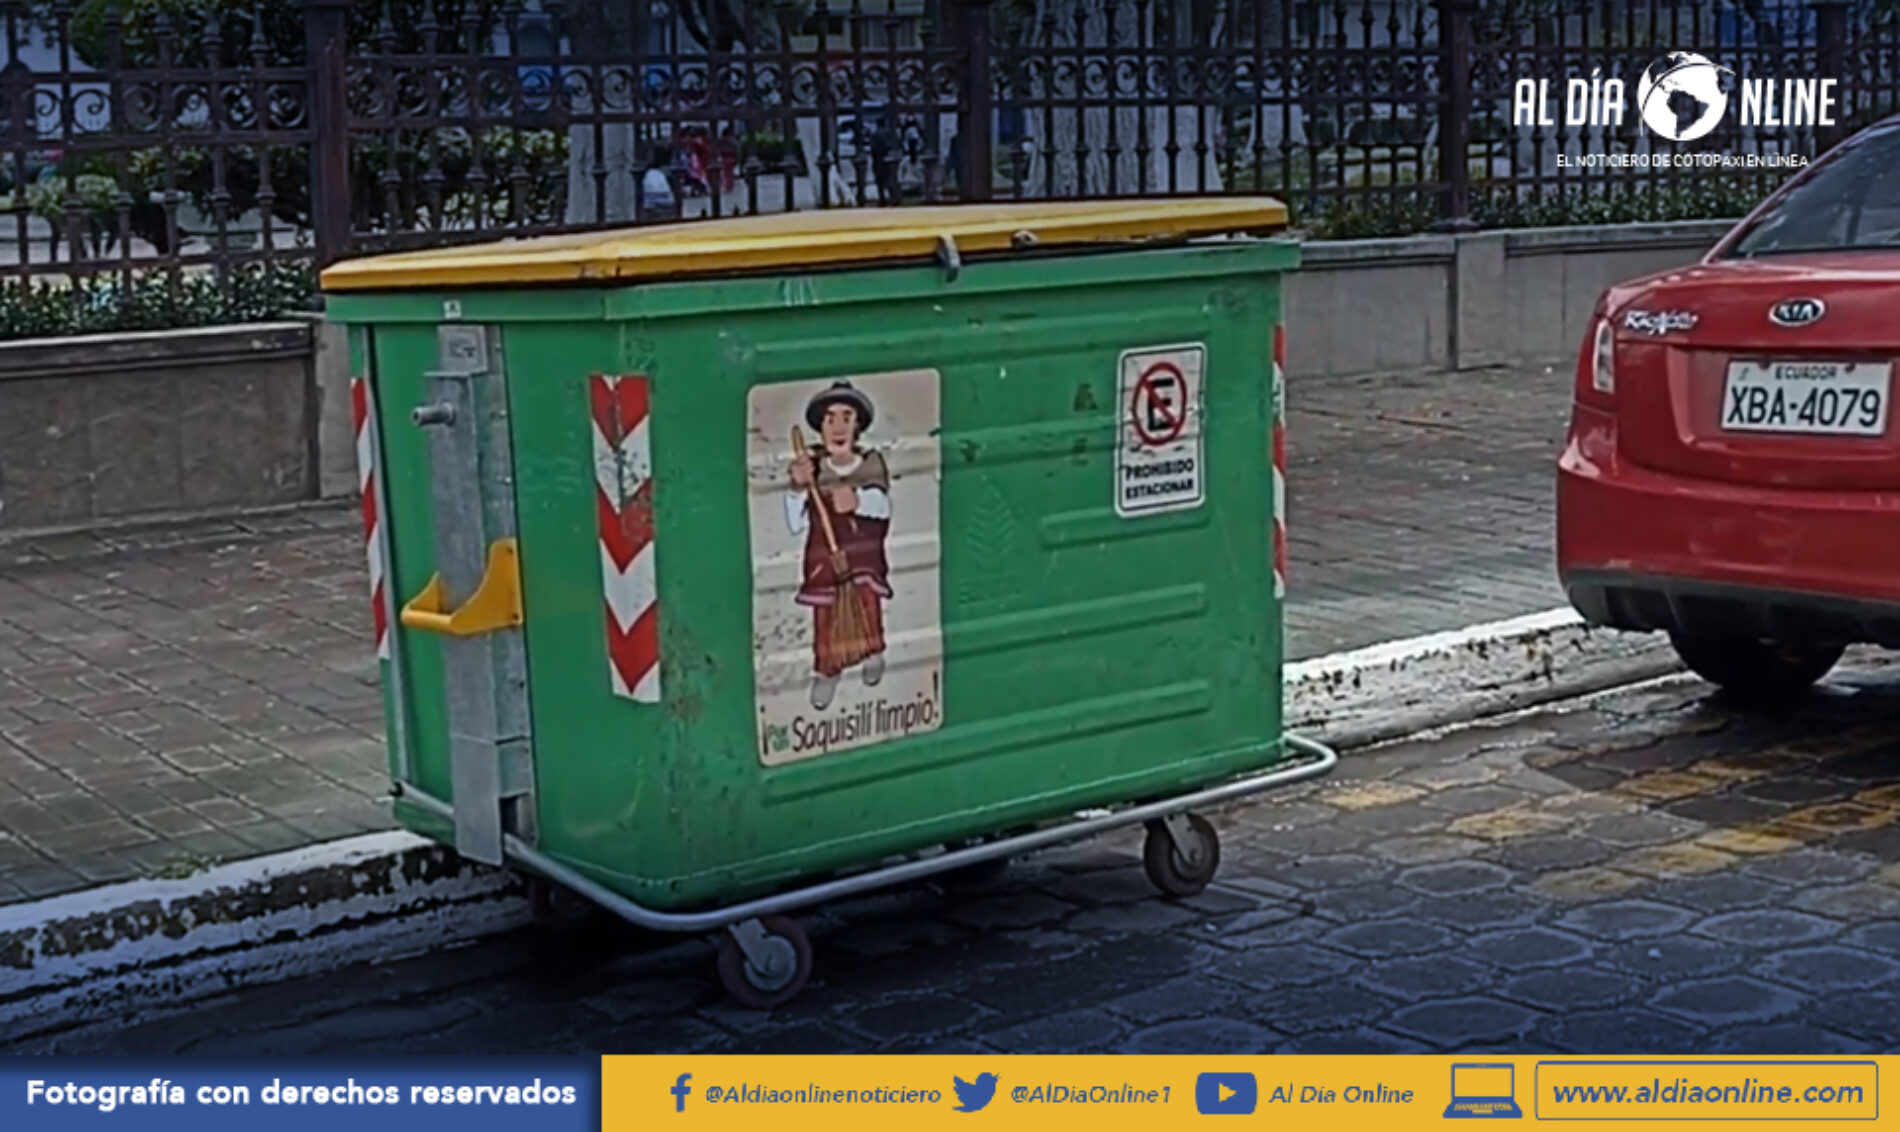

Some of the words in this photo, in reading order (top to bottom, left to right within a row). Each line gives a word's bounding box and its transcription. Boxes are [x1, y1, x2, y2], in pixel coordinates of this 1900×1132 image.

[1779, 302, 1815, 322] KIA
[1775, 365, 1838, 380] ECUADOR
[1727, 386, 1881, 428] XBA-4079
[1124, 458, 1194, 480] PROHIBIDO
[1125, 478, 1194, 500] ESTACIONAR
